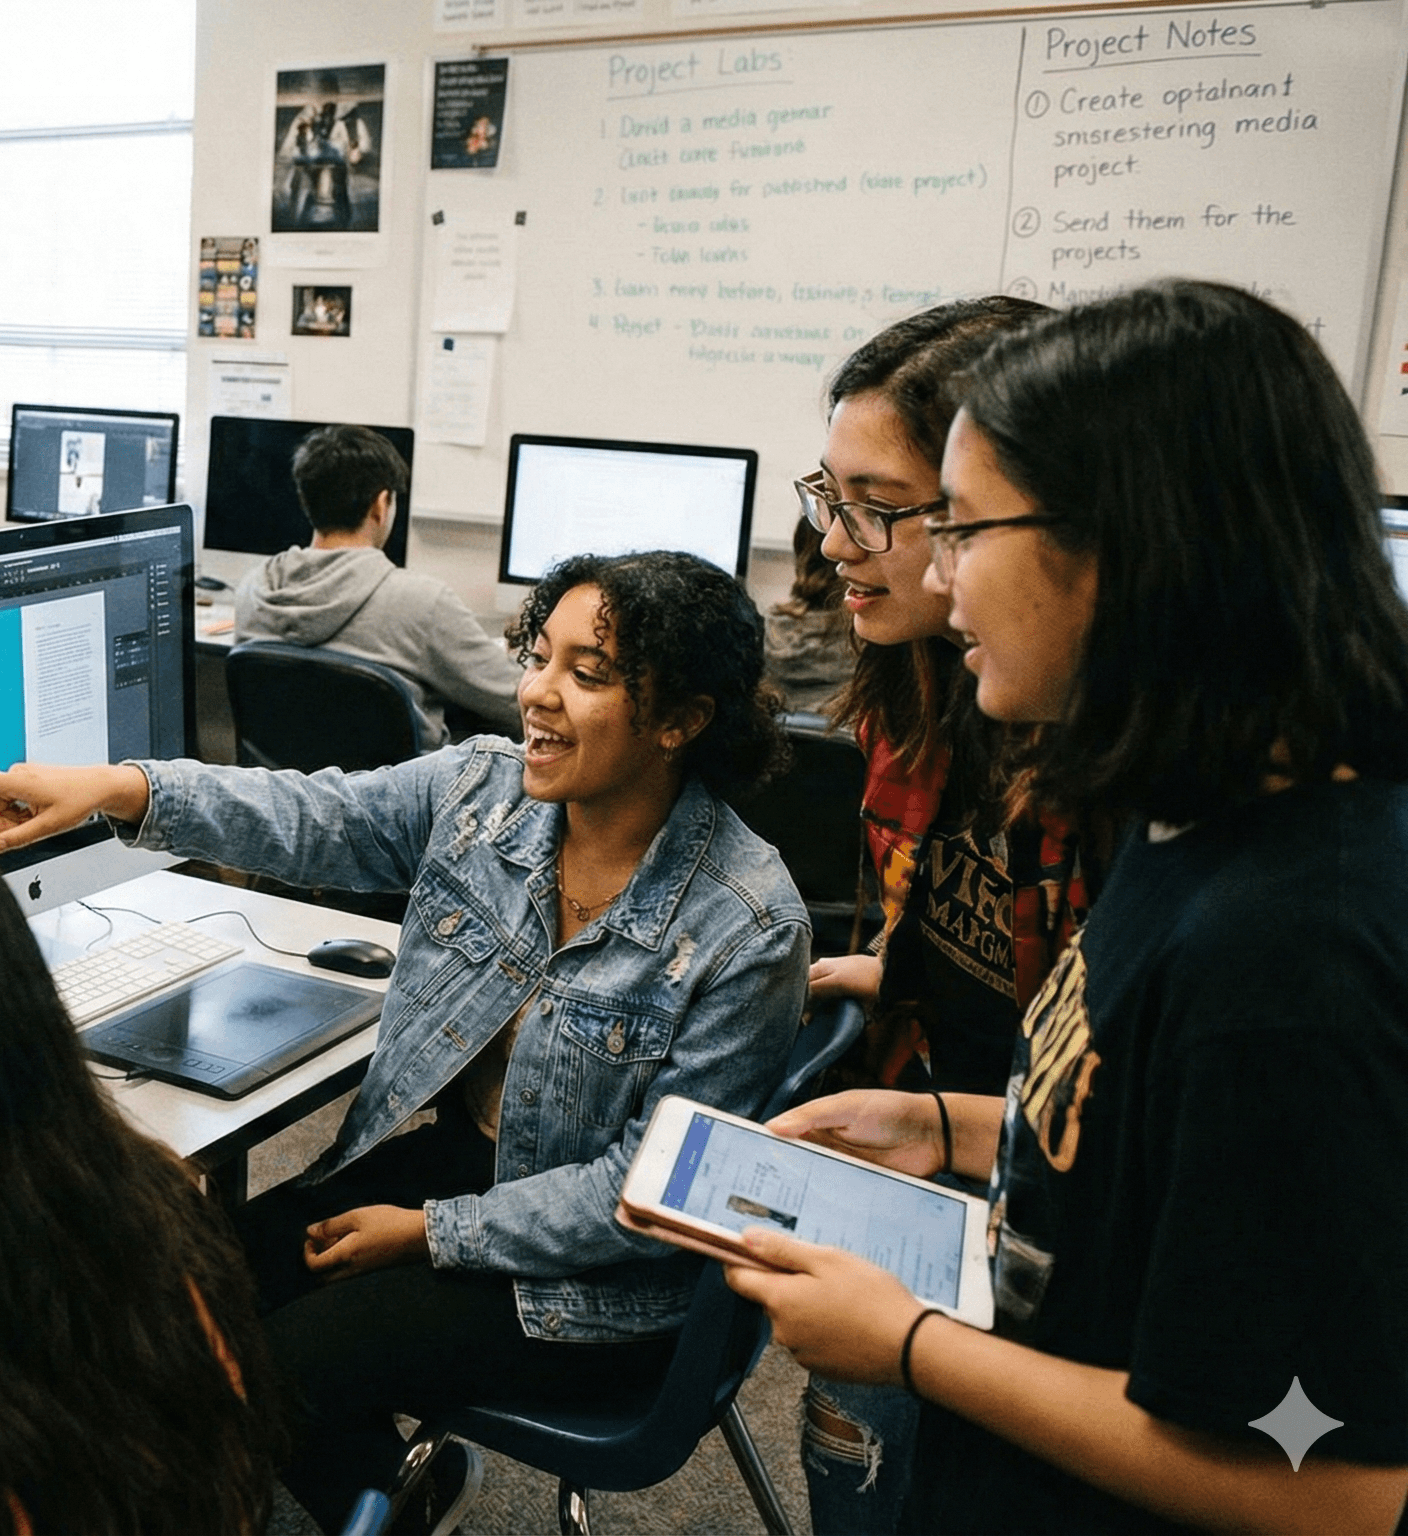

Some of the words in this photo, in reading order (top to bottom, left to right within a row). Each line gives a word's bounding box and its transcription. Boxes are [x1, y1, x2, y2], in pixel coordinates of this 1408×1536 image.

[1047, 25, 1150, 67] Project
[1167, 19, 1256, 50] Notes
[609, 51, 700, 95] Project
[1060, 86, 1143, 114] Create
[1236, 109, 1318, 134] media
[1053, 211, 1109, 234] Send
[1127, 209, 1185, 231] them
[1201, 205, 1237, 228] for
[1253, 203, 1297, 227] the
[1052, 240, 1141, 271] projects
